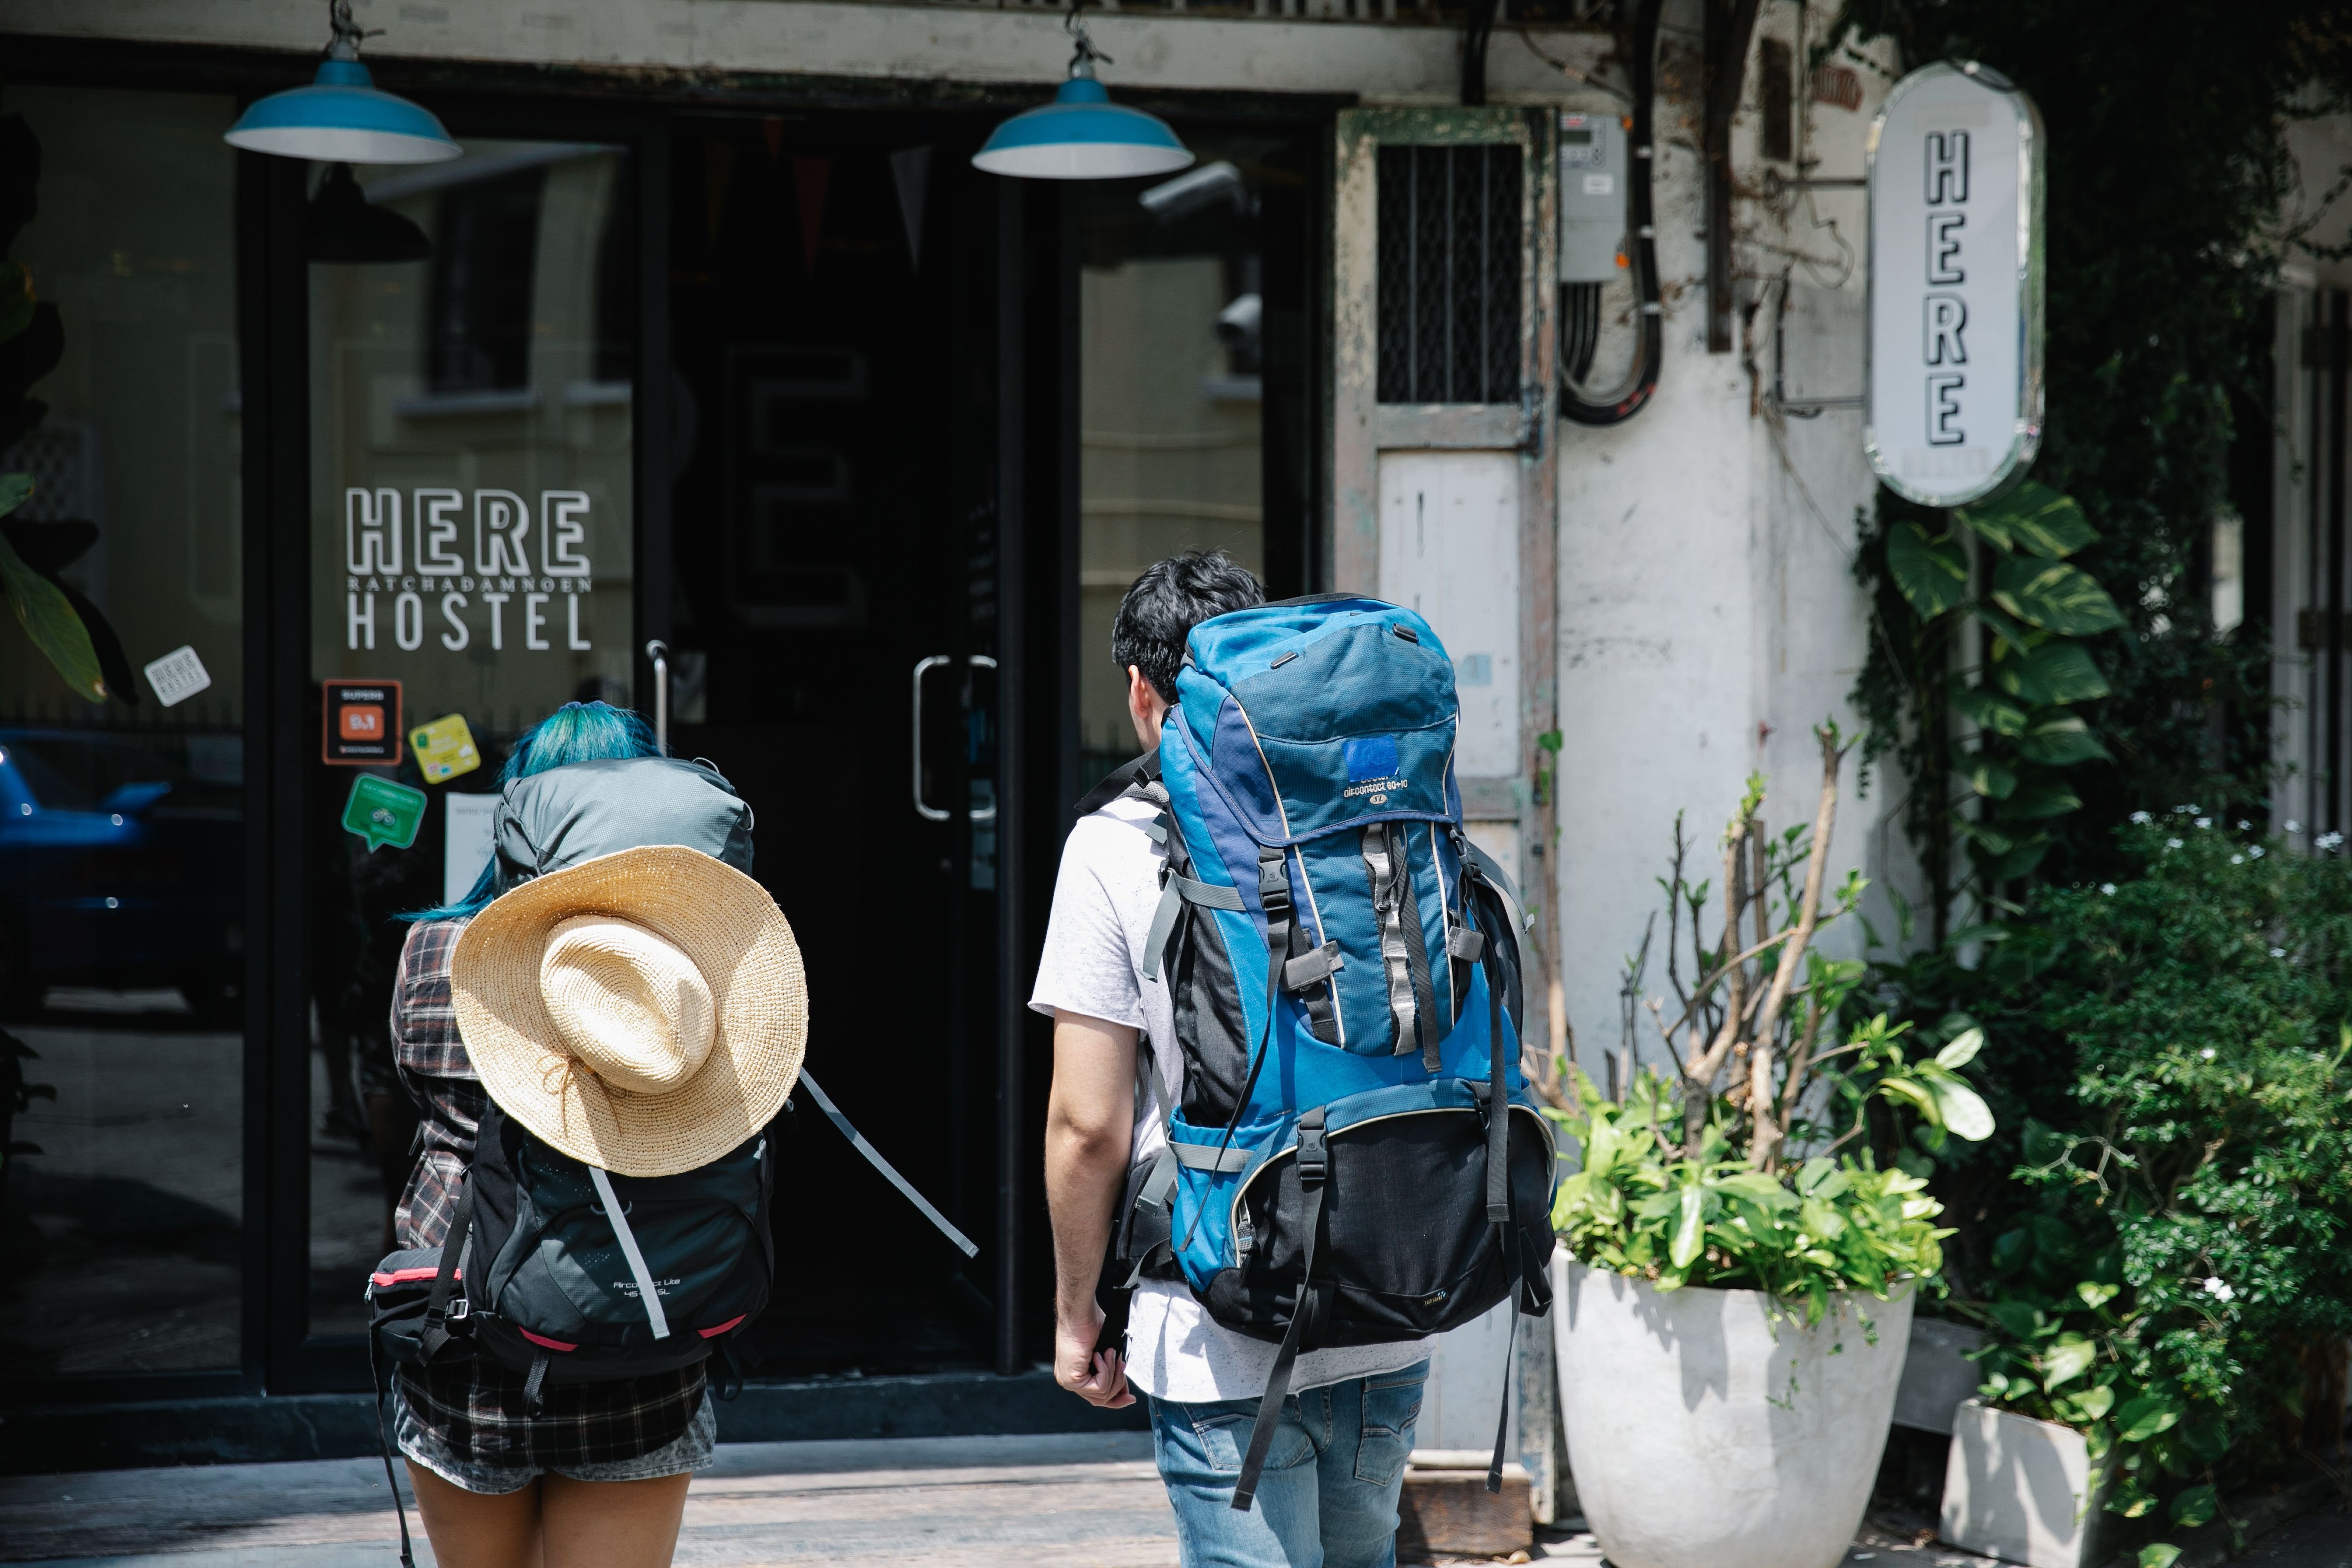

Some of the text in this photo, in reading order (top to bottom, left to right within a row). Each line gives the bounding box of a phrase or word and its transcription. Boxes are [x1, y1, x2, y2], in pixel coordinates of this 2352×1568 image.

[1923, 130, 1970, 446] HERE
[346, 487, 591, 576] HERE
[347, 576, 592, 593] RATCHADAMNOEN
[347, 592, 592, 651] HOSTEL
[349, 713, 375, 731] 9.1
